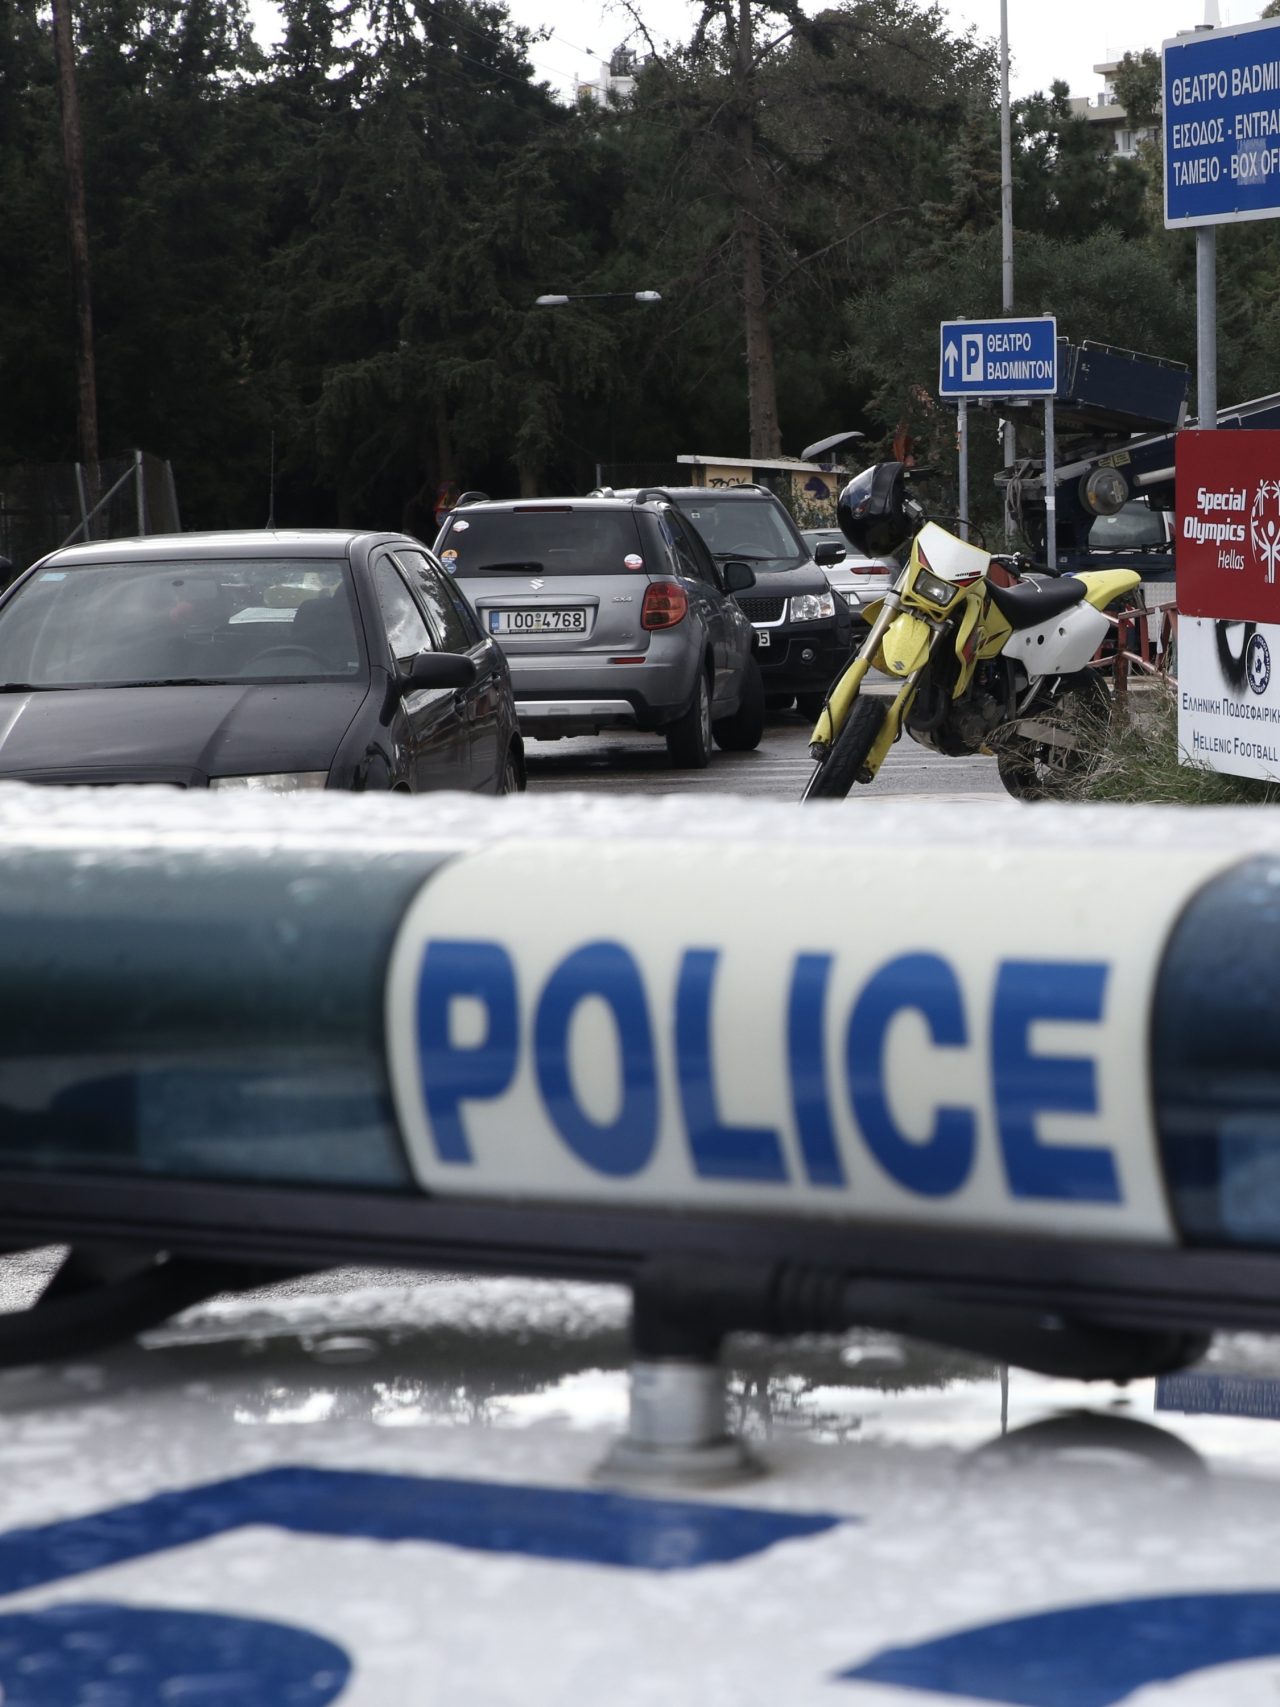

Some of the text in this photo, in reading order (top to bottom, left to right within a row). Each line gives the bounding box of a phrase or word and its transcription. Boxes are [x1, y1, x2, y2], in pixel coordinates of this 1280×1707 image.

[1172, 71, 1228, 107] ΘΕΑΤΡΟ
[1173, 118, 1225, 149] ΕΙΣΟΔΟΣ
[1173, 156, 1220, 187] ΤΑΜΕΙΟ
[1231, 151, 1258, 179] BOX
[966, 340, 980, 376] P
[987, 333, 1032, 353] ΘΕΑΤΡΟ
[987, 360, 1053, 380] BADMINTON
[1196, 487, 1247, 515] Special
[1183, 516, 1246, 546] Olympics
[1217, 549, 1245, 570] Hellas
[1182, 693, 1221, 716] ΕΛΛΗΝΙΚΗ
[1193, 729, 1232, 752] HELLENIC
[1234, 737, 1279, 762] FOOTBALL
[414, 940, 1124, 1206] POLICE
